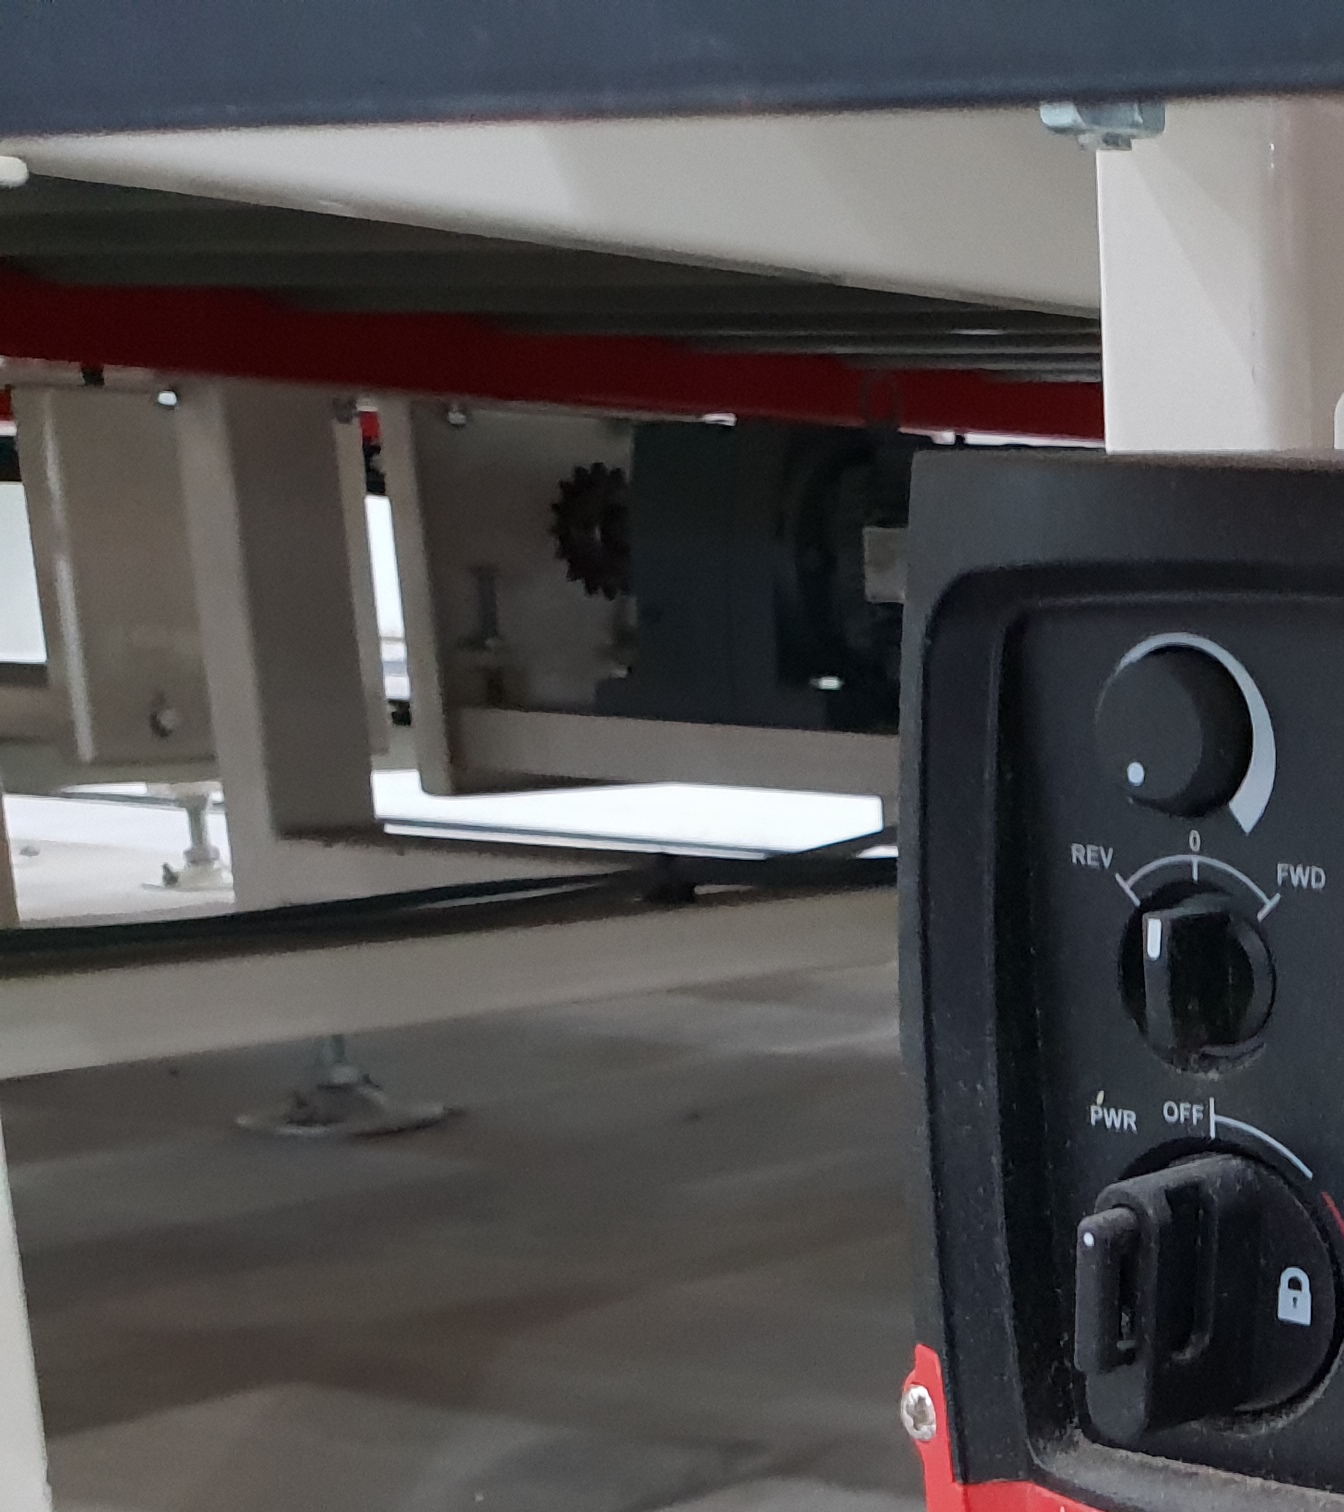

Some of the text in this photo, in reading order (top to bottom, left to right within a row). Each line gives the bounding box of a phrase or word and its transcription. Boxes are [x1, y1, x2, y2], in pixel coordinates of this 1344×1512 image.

[1188, 829, 1200, 852] 0
[1071, 843, 1114, 869] REV
[1277, 863, 1326, 890] FWD
[1089, 1104, 1138, 1133] PWR
[1162, 1100, 1204, 1127] OFF
